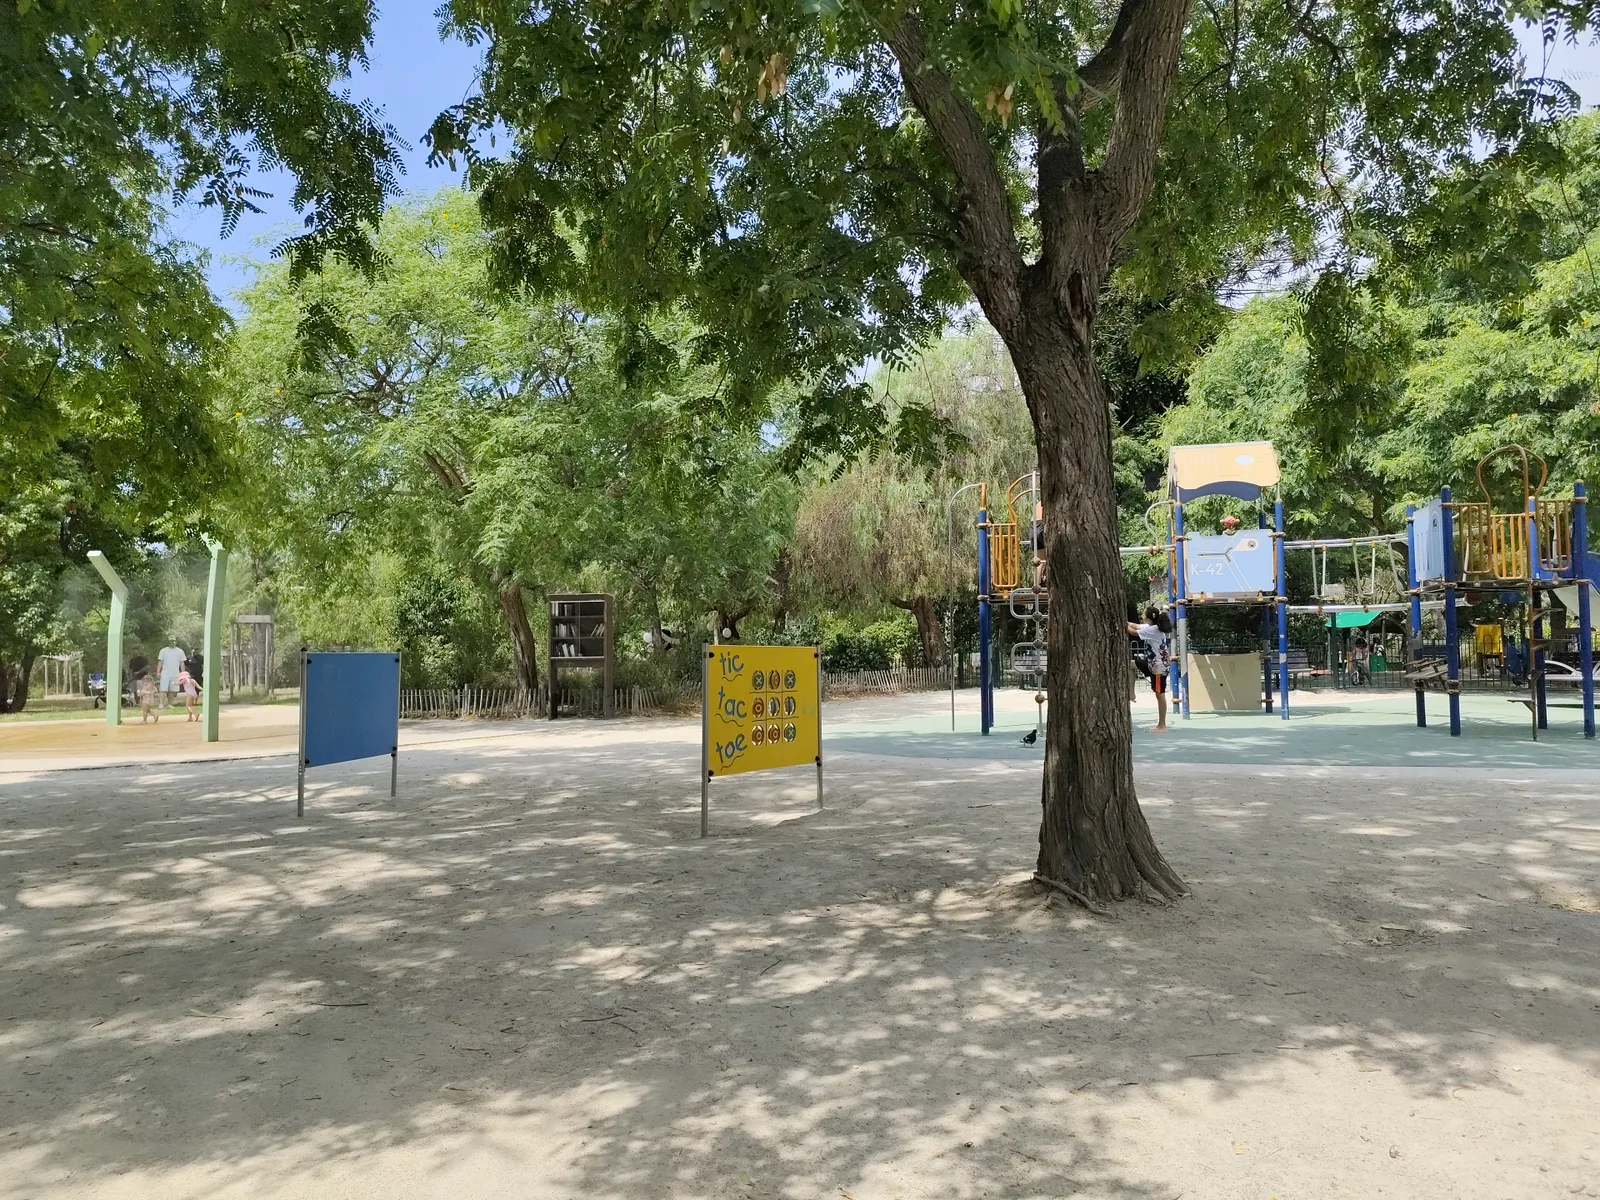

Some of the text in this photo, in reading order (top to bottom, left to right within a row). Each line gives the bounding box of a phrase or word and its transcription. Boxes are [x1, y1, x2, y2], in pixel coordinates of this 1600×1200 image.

[1191, 563, 1224, 576] K-42
[719, 651, 744, 675] tic
[718, 686, 747, 718] tac
[716, 733, 747, 763] toe
